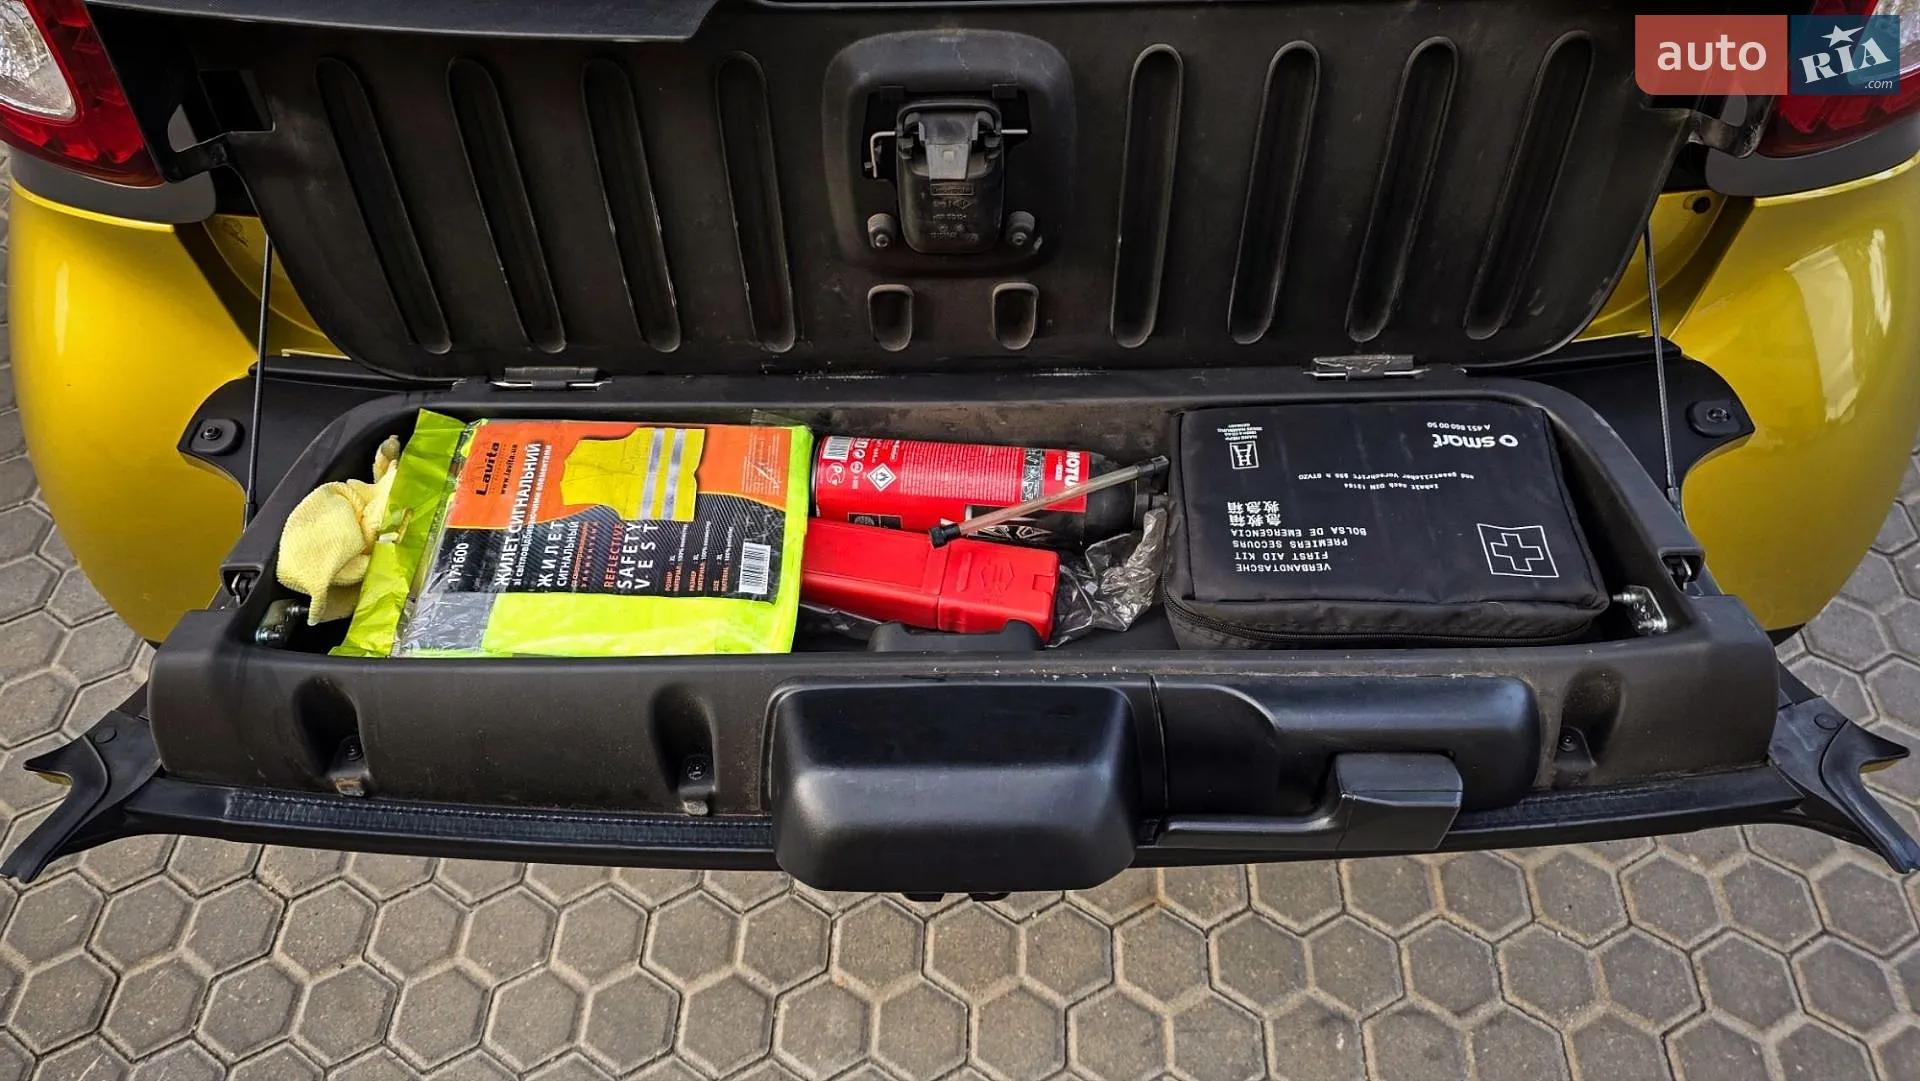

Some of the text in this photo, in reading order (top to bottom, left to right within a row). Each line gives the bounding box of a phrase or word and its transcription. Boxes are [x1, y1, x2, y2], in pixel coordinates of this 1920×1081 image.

[1432, 432, 1496, 449] smart
[476, 442, 499, 496] Lavita
[500, 444, 517, 494] www.lavita.ua
[1064, 451, 1080, 489] MOTU
[494, 443, 541, 586] ЖИЛЕТ СИГНАЛЬНИЙ
[1227, 500, 1279, 513] 救急箱
[1229, 513, 1281, 526] 急救箱
[1230, 526, 1366, 537] BOLSA DE EMERGENCIA
[1232, 537, 1347, 548] PREMIERS SECOURS
[448, 543, 469, 583] 171600
[537, 522, 564, 587] ЖИЛЕТ
[557, 521, 579, 586] СИГНАЛЬНЫЙ
[604, 524, 623, 588] REFLECTIVE
[617, 522, 641, 589] SAFETY
[634, 524, 659, 589] VEST
[1234, 551, 1328, 560] FIRST AID KIT
[1236, 562, 1331, 572] VERBANDTASCHE
